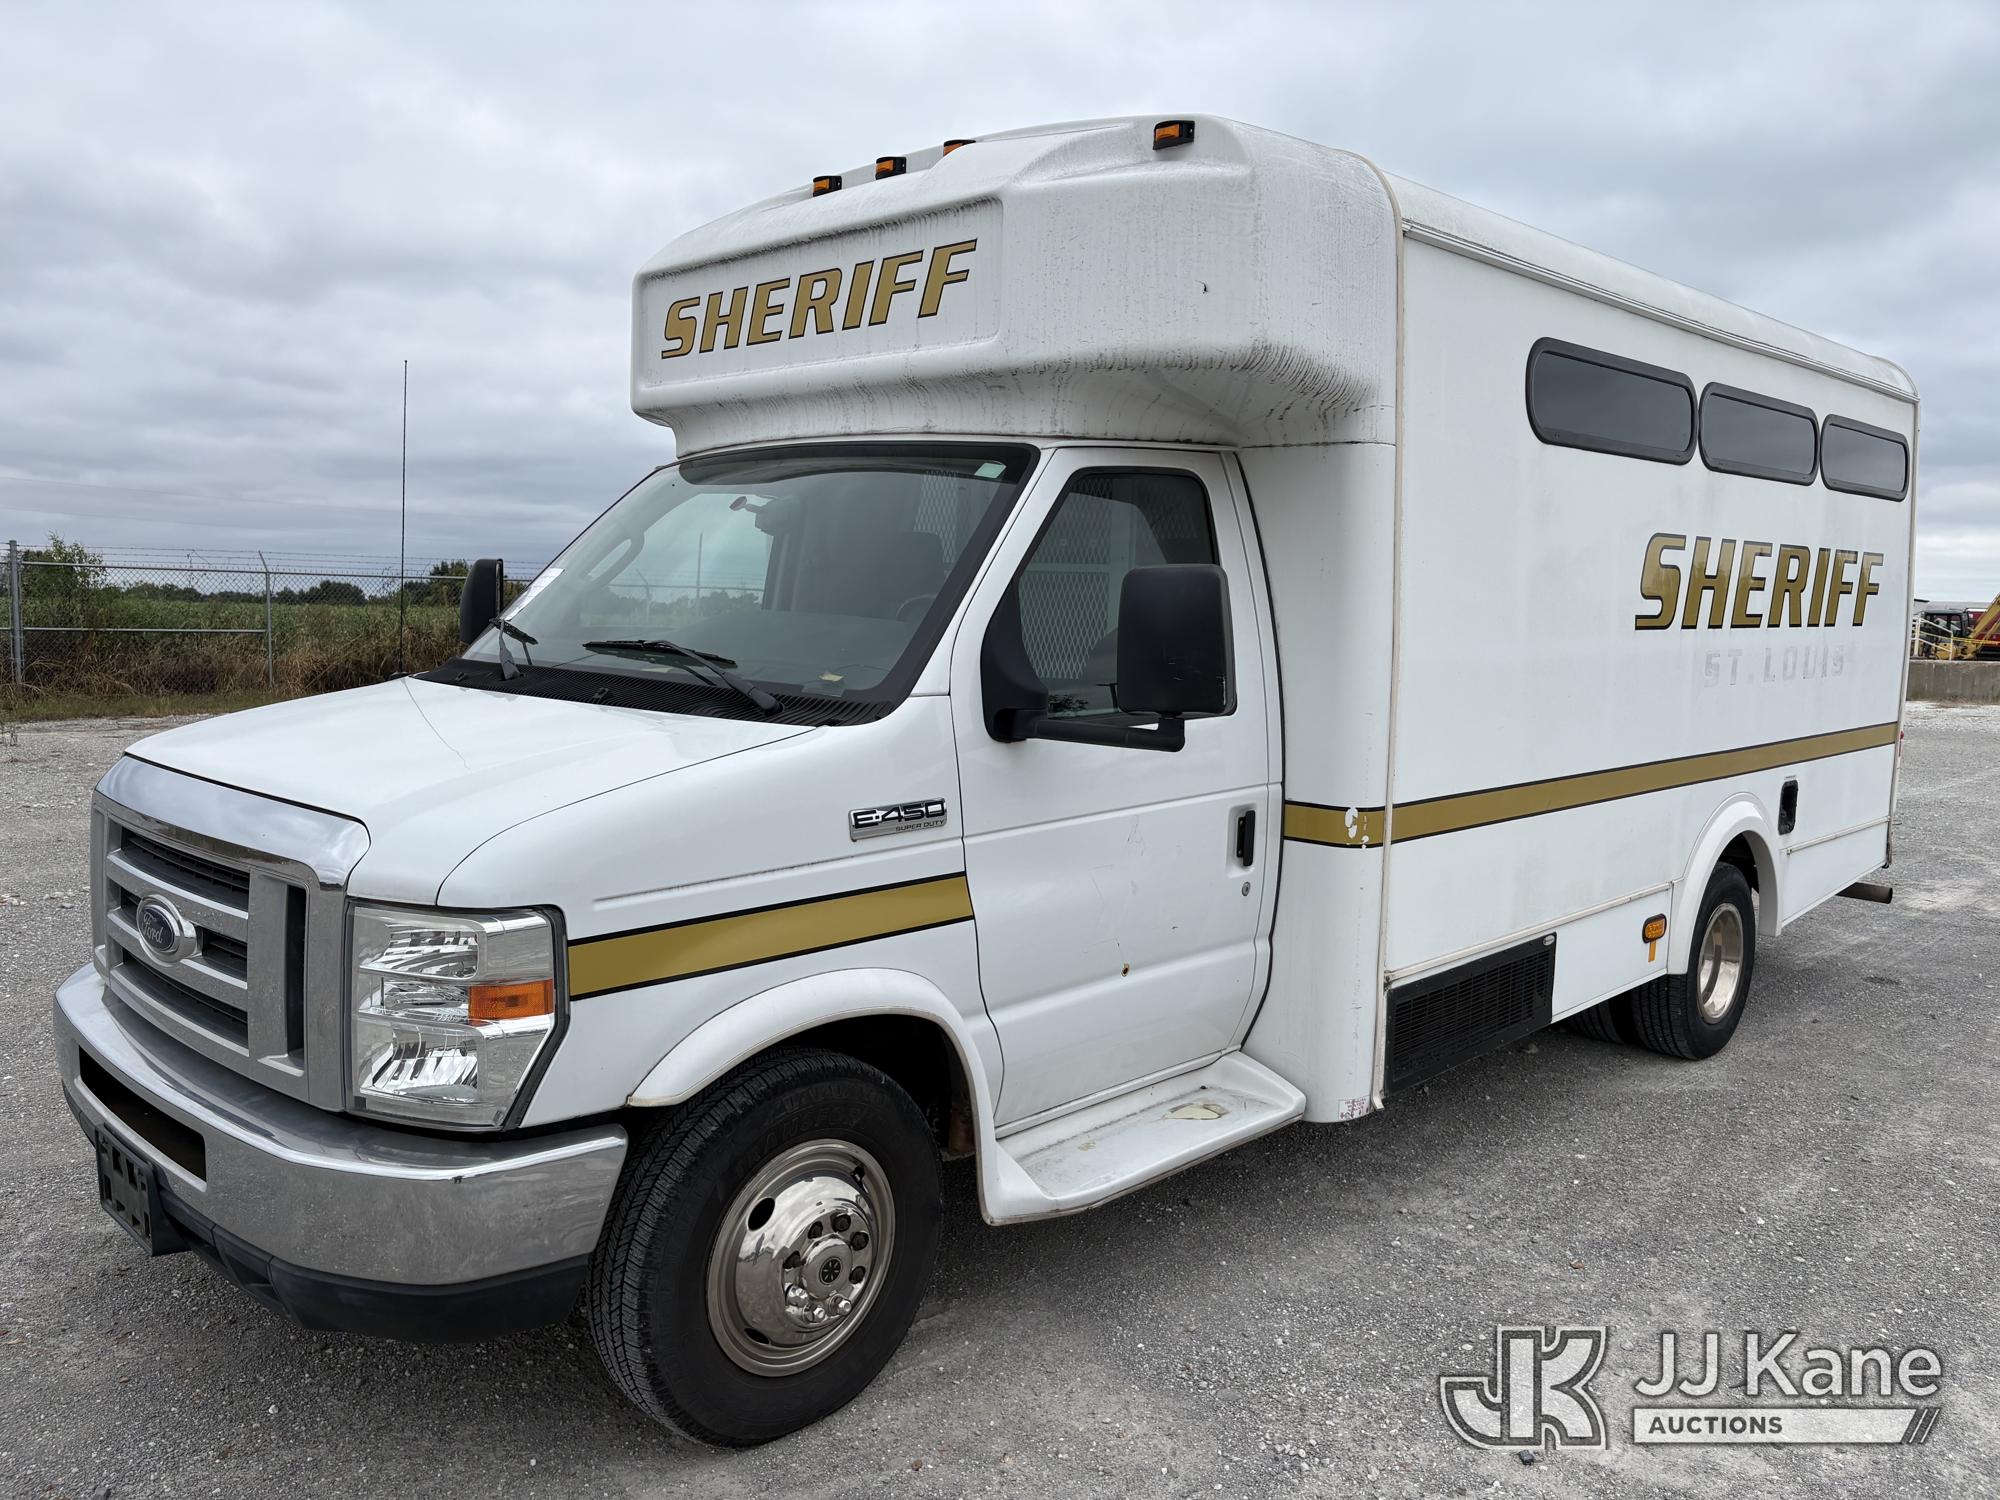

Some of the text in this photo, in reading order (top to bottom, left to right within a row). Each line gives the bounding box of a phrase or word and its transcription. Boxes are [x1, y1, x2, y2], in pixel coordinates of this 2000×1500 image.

[661, 238, 978, 359] SHERIFF
[1635, 532, 1884, 630] SHERIFF
[1763, 645, 1845, 682] LOUIS
[852, 799, 946, 829] E-450
[896, 819, 945, 832] SUPER DUTY
[142, 912, 164, 944] Ford
